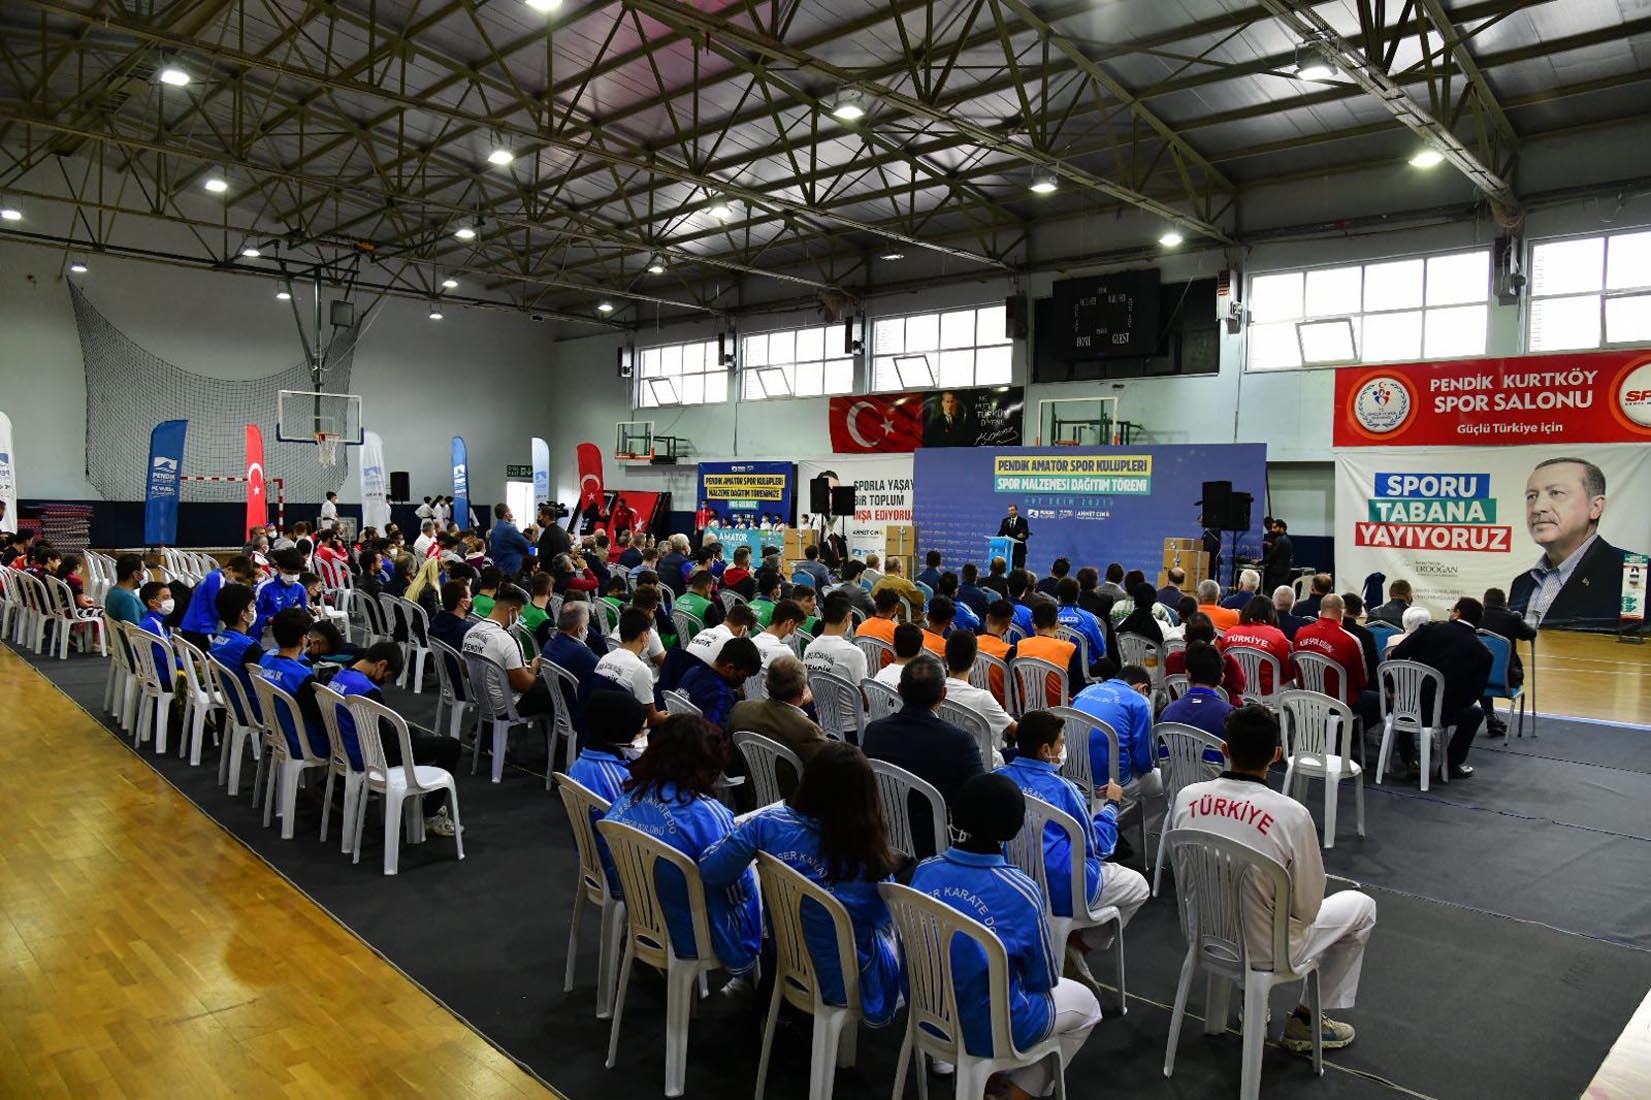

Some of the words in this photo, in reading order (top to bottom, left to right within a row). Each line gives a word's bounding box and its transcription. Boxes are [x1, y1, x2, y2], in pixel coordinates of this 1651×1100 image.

[1429, 373, 1494, 392] PENDİK
[1503, 367, 1599, 389] KURTKÖY
[1434, 394, 1490, 414] SPOR
[1493, 390, 1593, 412] SALONU
[1457, 423, 1491, 436] Güçlü
[1492, 421, 1538, 435] Türkiye
[1540, 422, 1563, 435] için
[1070, 459, 1094, 472] SPOR
[853, 480, 885, 491] SPORLA
[997, 478, 1020, 490] SPOR
[1071, 477, 1110, 491] DAĞITIM
[1386, 475, 1478, 498] SPORU
[869, 494, 905, 506] TOPLUM
[1375, 500, 1487, 523] TABANA
[1359, 524, 1508, 550] YAYIYORUZ
[1227, 633, 1269, 648] TÜRKİYE
[1188, 794, 1275, 836] TÜRKİYE
[943, 886, 989, 916] KARATE
